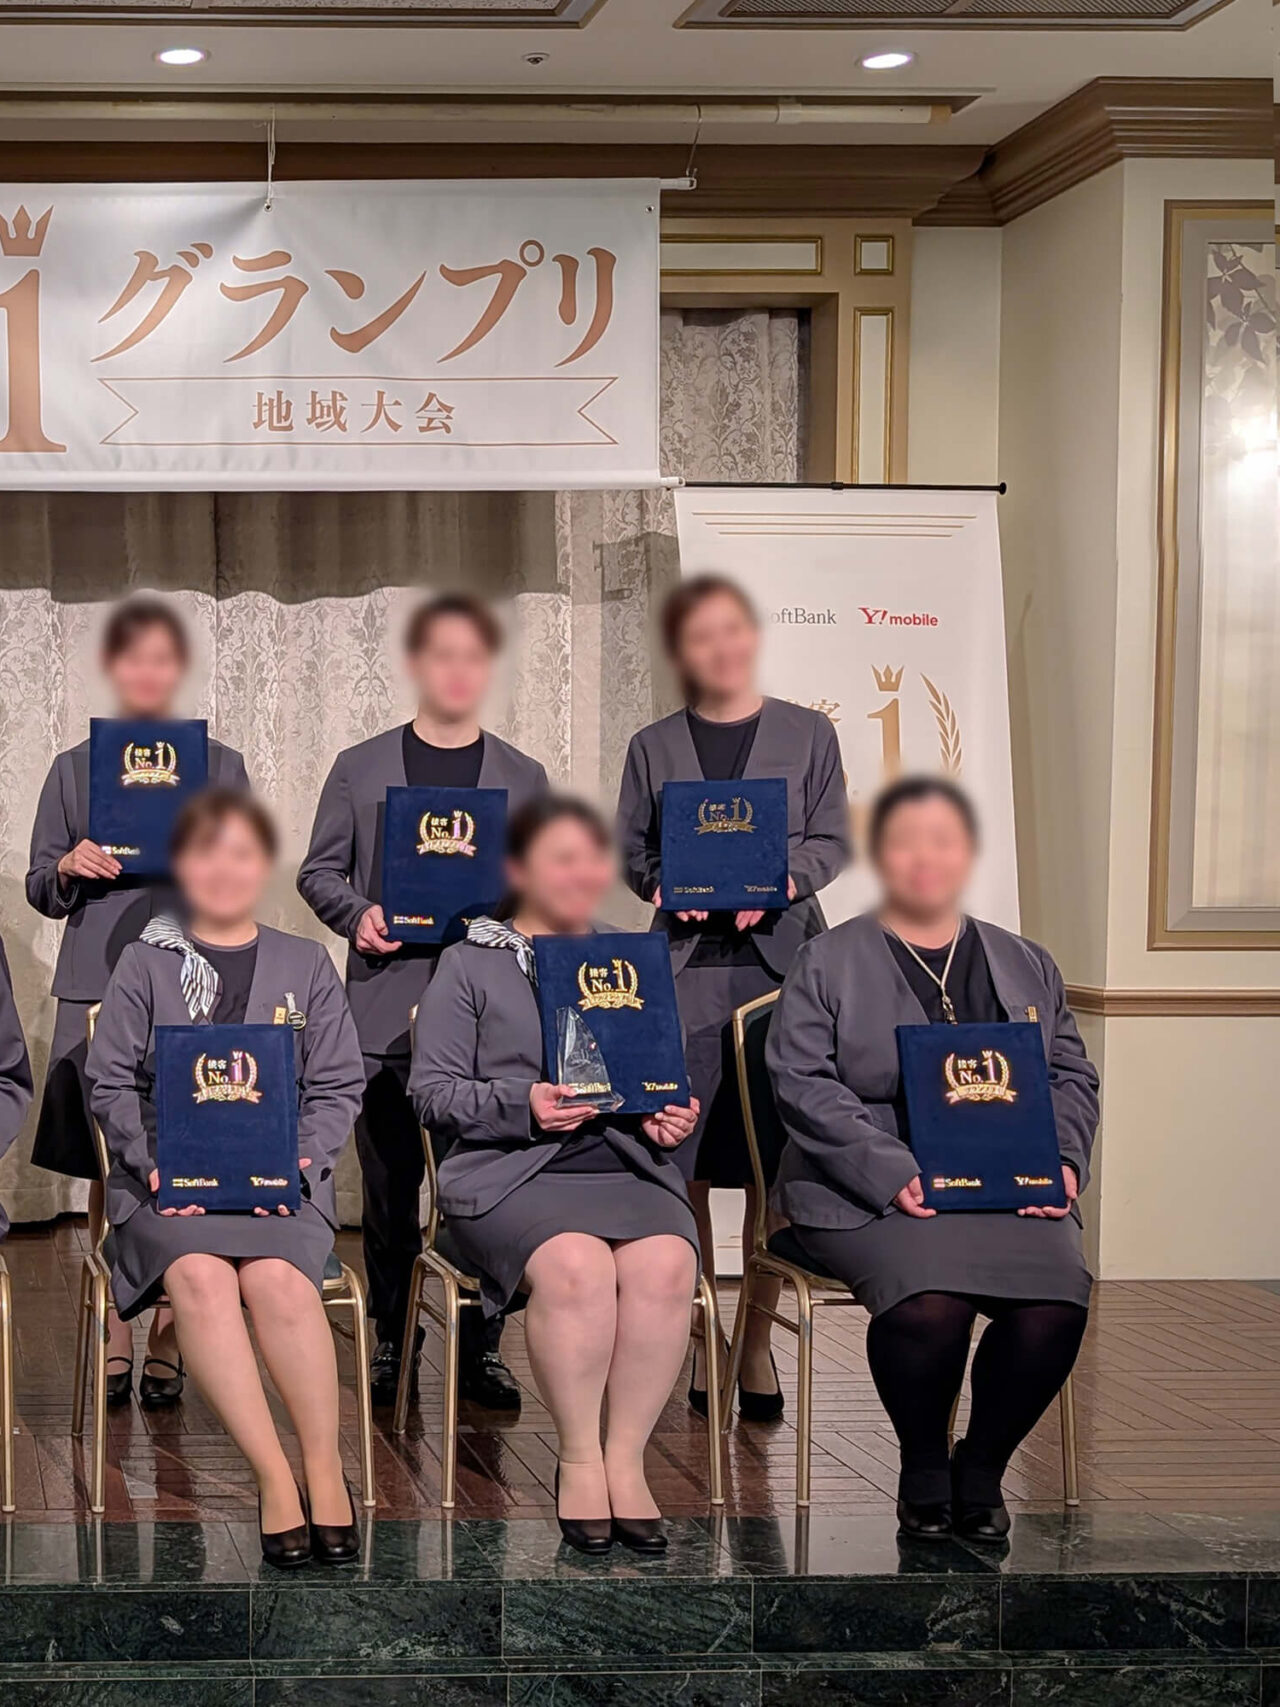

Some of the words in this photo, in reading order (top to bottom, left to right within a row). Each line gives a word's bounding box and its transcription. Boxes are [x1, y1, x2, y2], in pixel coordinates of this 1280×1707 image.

[90, 239, 618, 368] グランプリ
[251, 390, 457, 435] 地域大会
[770, 606, 838, 625] oftBank
[858, 607, 939, 627] Y!mobile
